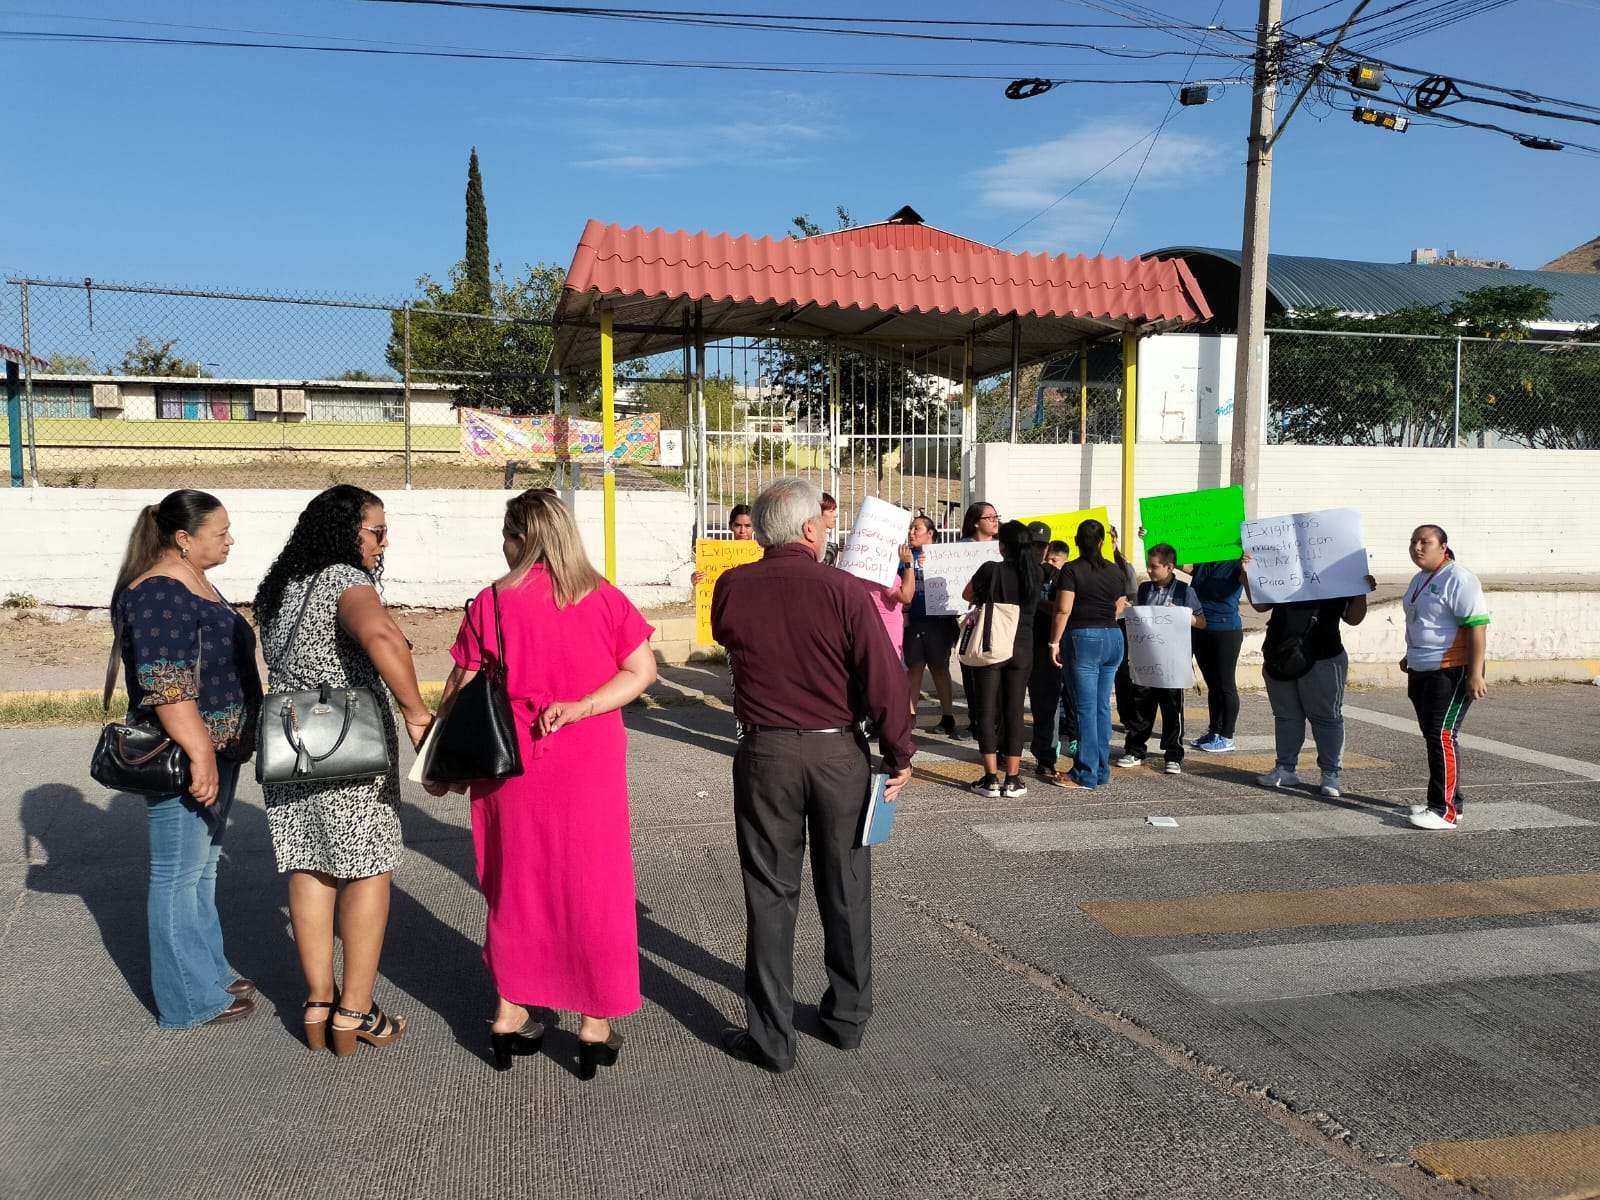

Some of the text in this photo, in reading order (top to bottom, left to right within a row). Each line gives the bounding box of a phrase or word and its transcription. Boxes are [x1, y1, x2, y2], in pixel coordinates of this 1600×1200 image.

[1246, 518, 1320, 538] Exigimos
[1252, 540, 1302, 552] maestro
[1308, 536, 1335, 546] con
[1258, 576, 1286, 588] Para
